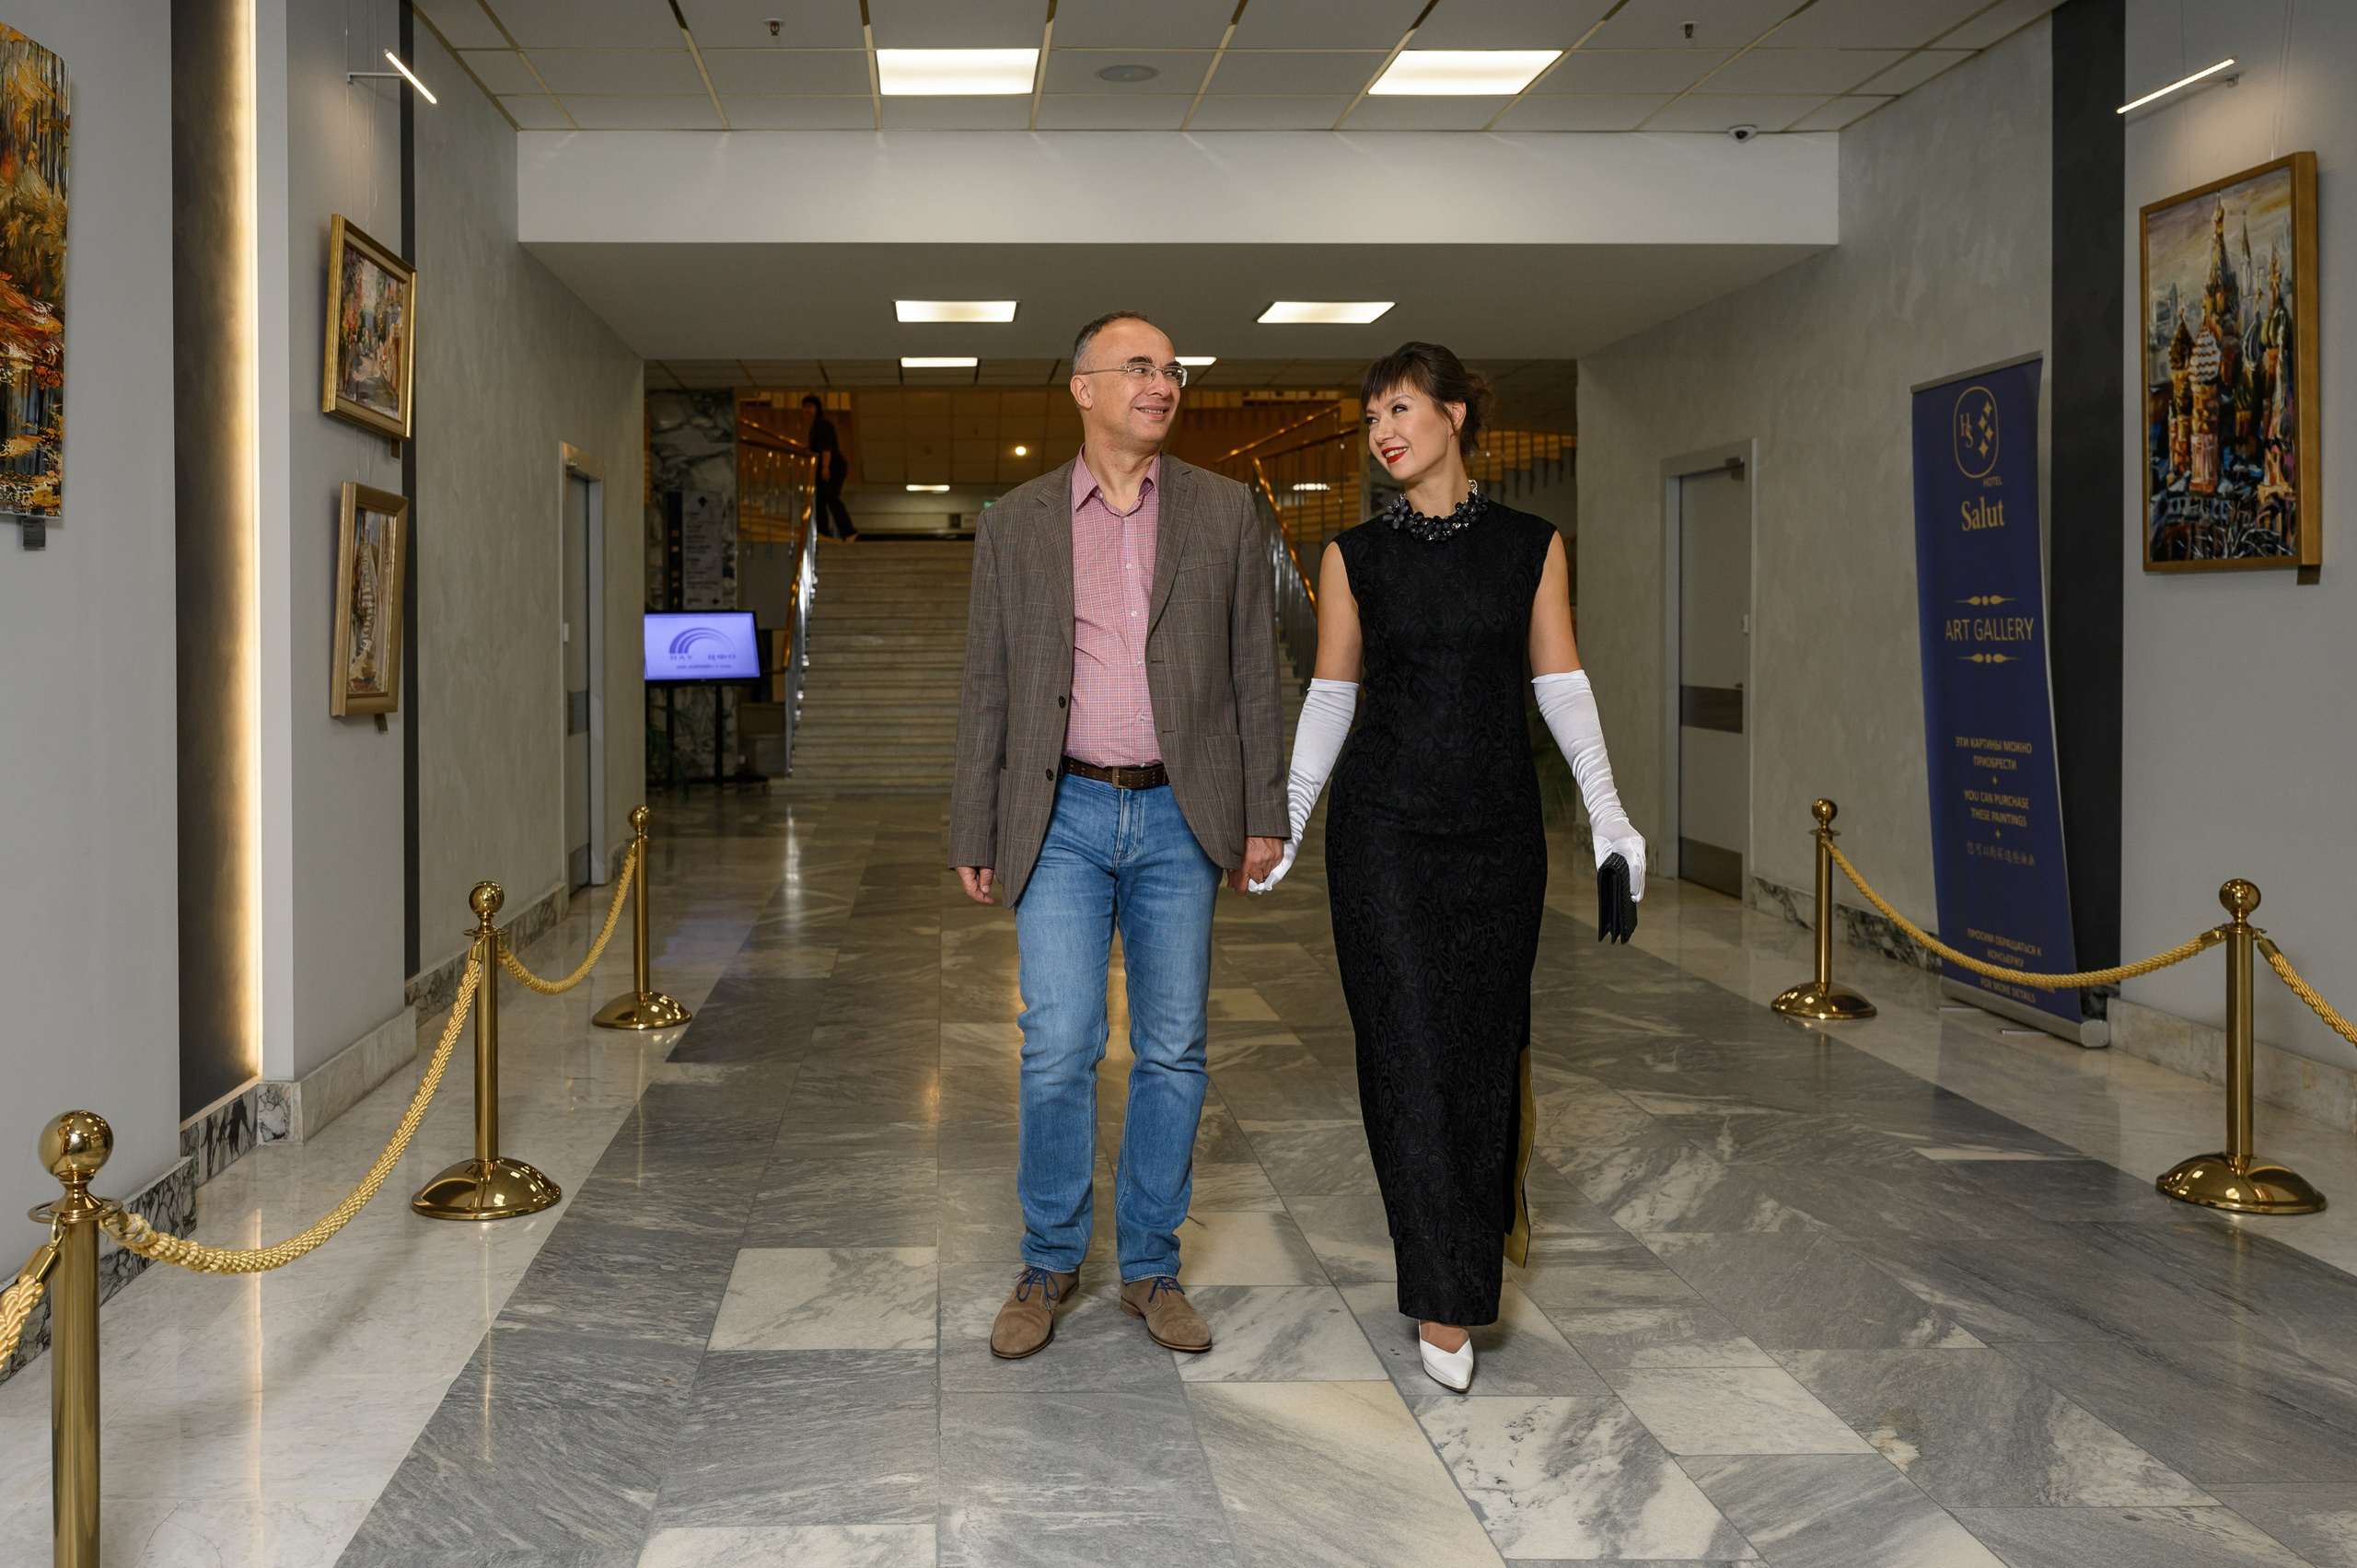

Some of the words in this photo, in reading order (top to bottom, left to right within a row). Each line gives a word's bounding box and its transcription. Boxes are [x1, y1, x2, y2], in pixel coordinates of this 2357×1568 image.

[1983, 476, 2003, 487] HOTEL
[1961, 495, 2005, 531] Salut
[1945, 619, 1970, 641] ART
[1974, 617, 2034, 641] GALLERY
[1956, 737, 1968, 748] ЭТИ
[1970, 738, 2002, 751] КАРТИНЫ
[2003, 741, 2033, 754] МОЖНО
[1973, 756, 2016, 771] ПРИОБРЕСТИ
[1964, 790, 1979, 801] YOU
[1980, 792, 1993, 804] CAN
[1994, 794, 2029, 810] PURCHASE
[1970, 807, 1990, 821] THESE
[1991, 811, 2027, 827] PAINTINGS
[1968, 928, 1994, 943] ПРОСИМ
[1995, 936, 2036, 956] ОБРАЩАТЬСЯ
[1987, 949, 2024, 968] КОНСЬЕРЖУ
[1980, 978, 1991, 988] FOR
[1993, 981, 2011, 995] MORE
[2013, 987, 2036, 1004] DETAILS
